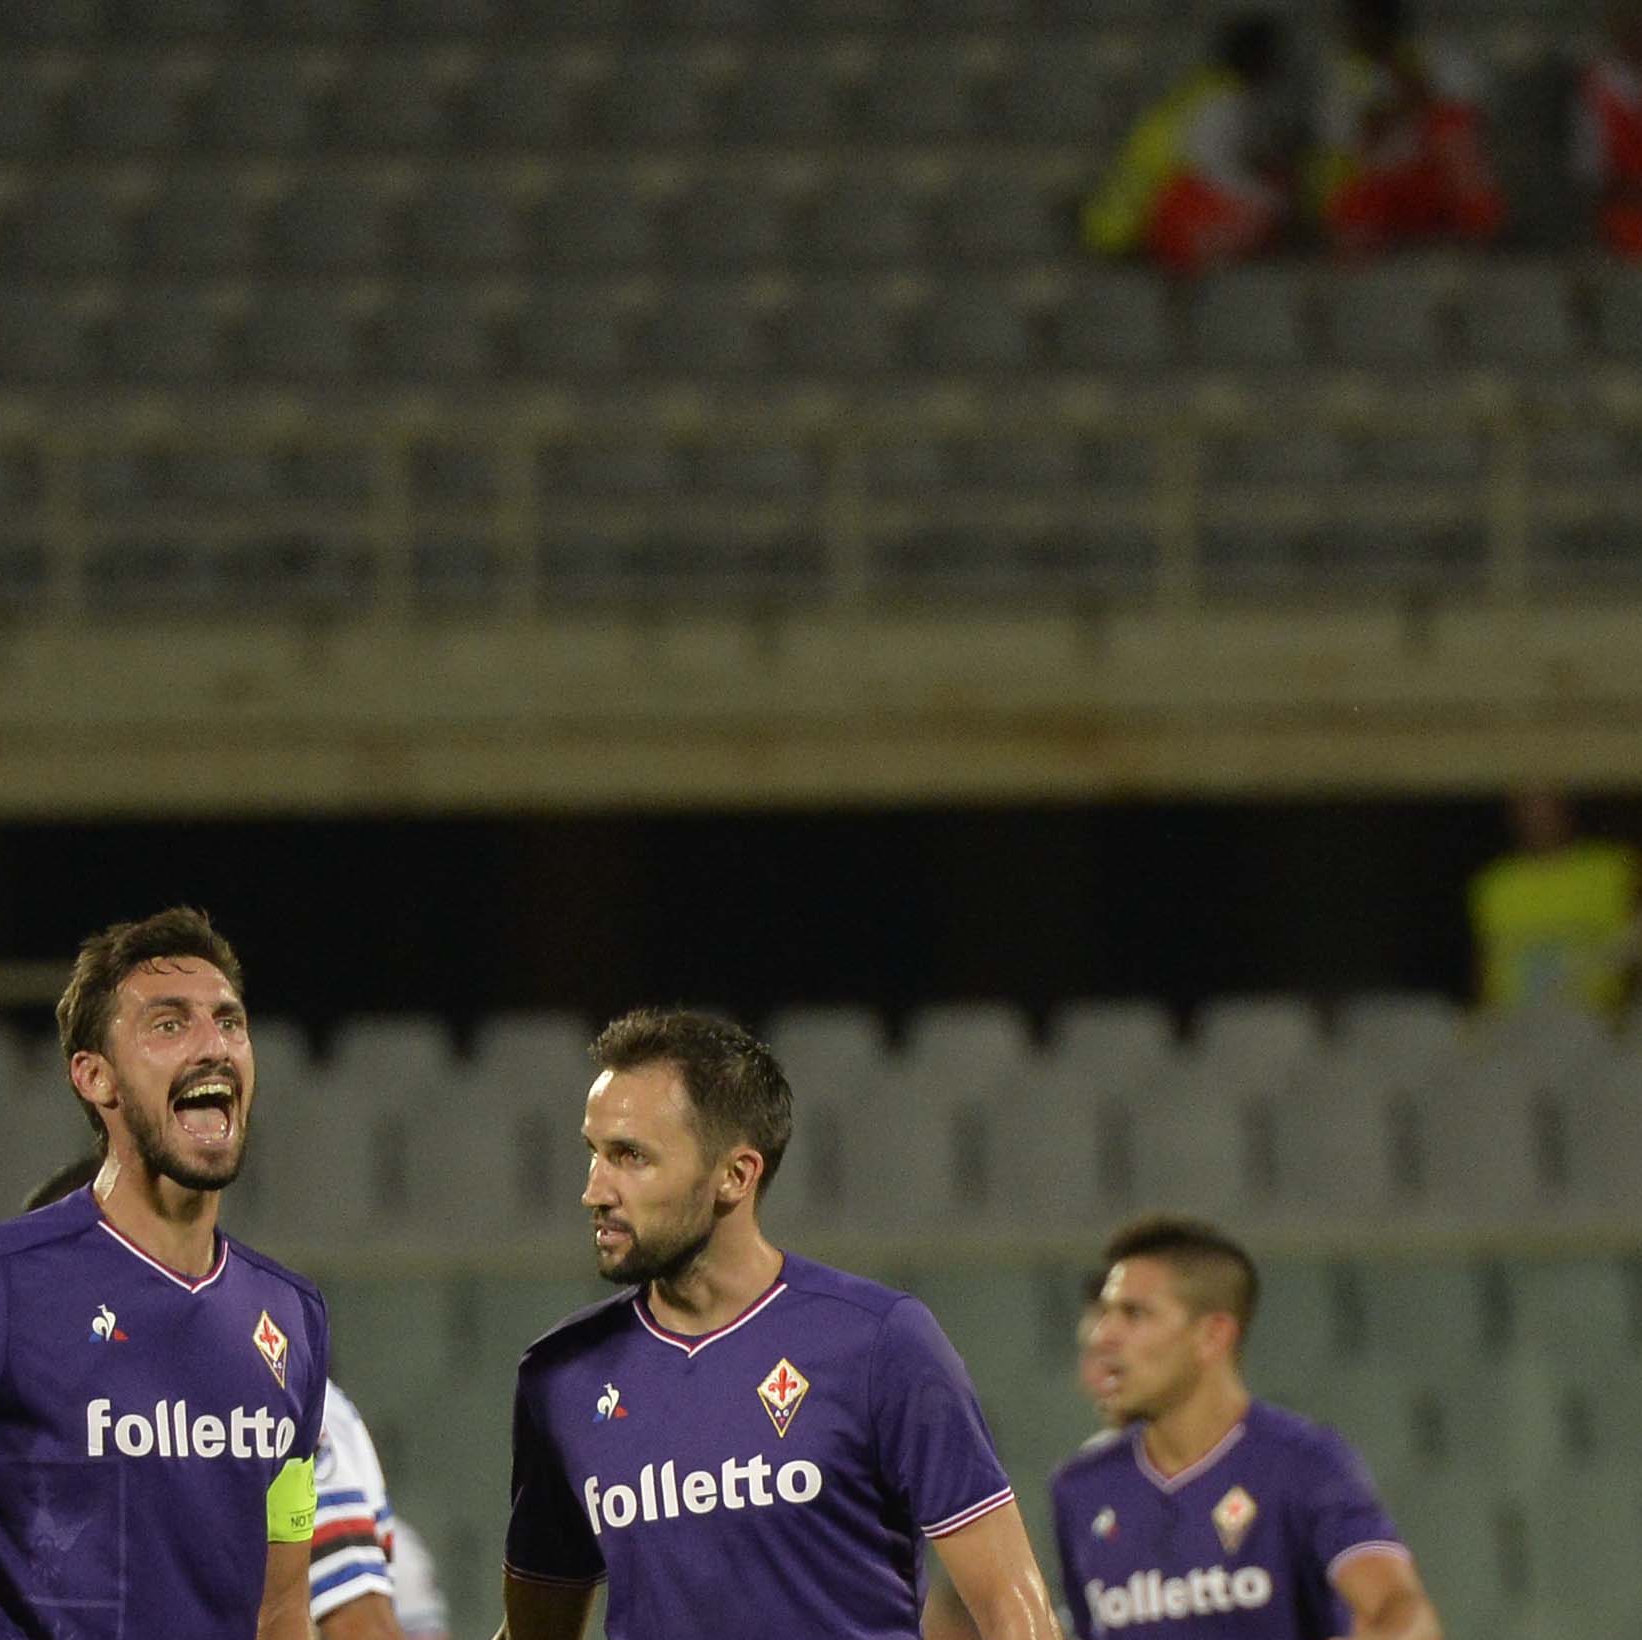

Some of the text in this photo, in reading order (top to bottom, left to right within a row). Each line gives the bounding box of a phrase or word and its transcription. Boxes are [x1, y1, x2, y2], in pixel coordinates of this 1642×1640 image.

[87, 1398, 295, 1459] folletto
[584, 1453, 823, 1536] folletto
[1085, 1563, 1273, 1638] folletto
